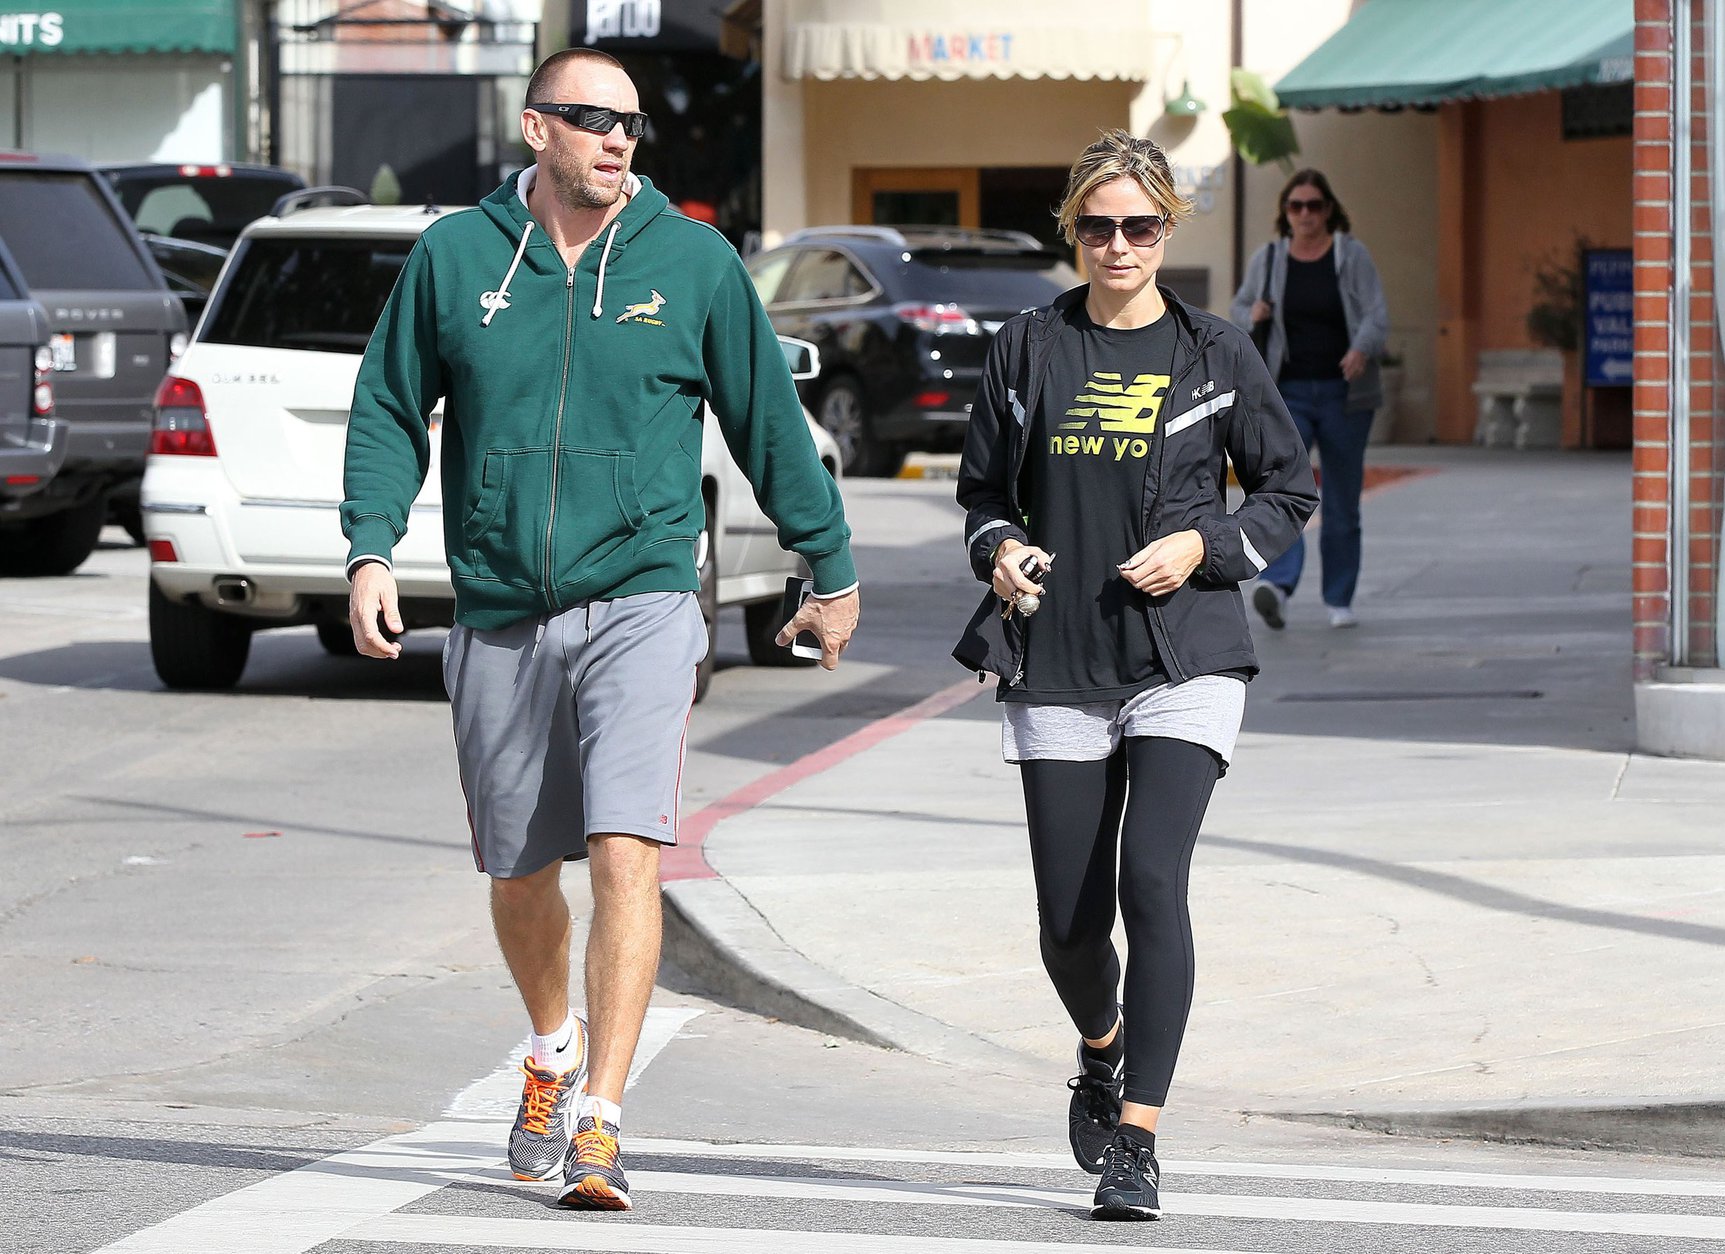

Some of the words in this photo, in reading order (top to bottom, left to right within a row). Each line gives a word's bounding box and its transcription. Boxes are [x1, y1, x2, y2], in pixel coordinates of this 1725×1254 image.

[907, 33, 1014, 62] MARKET
[55, 310, 123, 320] ROVER
[1050, 434, 1105, 456] new
[1112, 437, 1152, 462] yo
